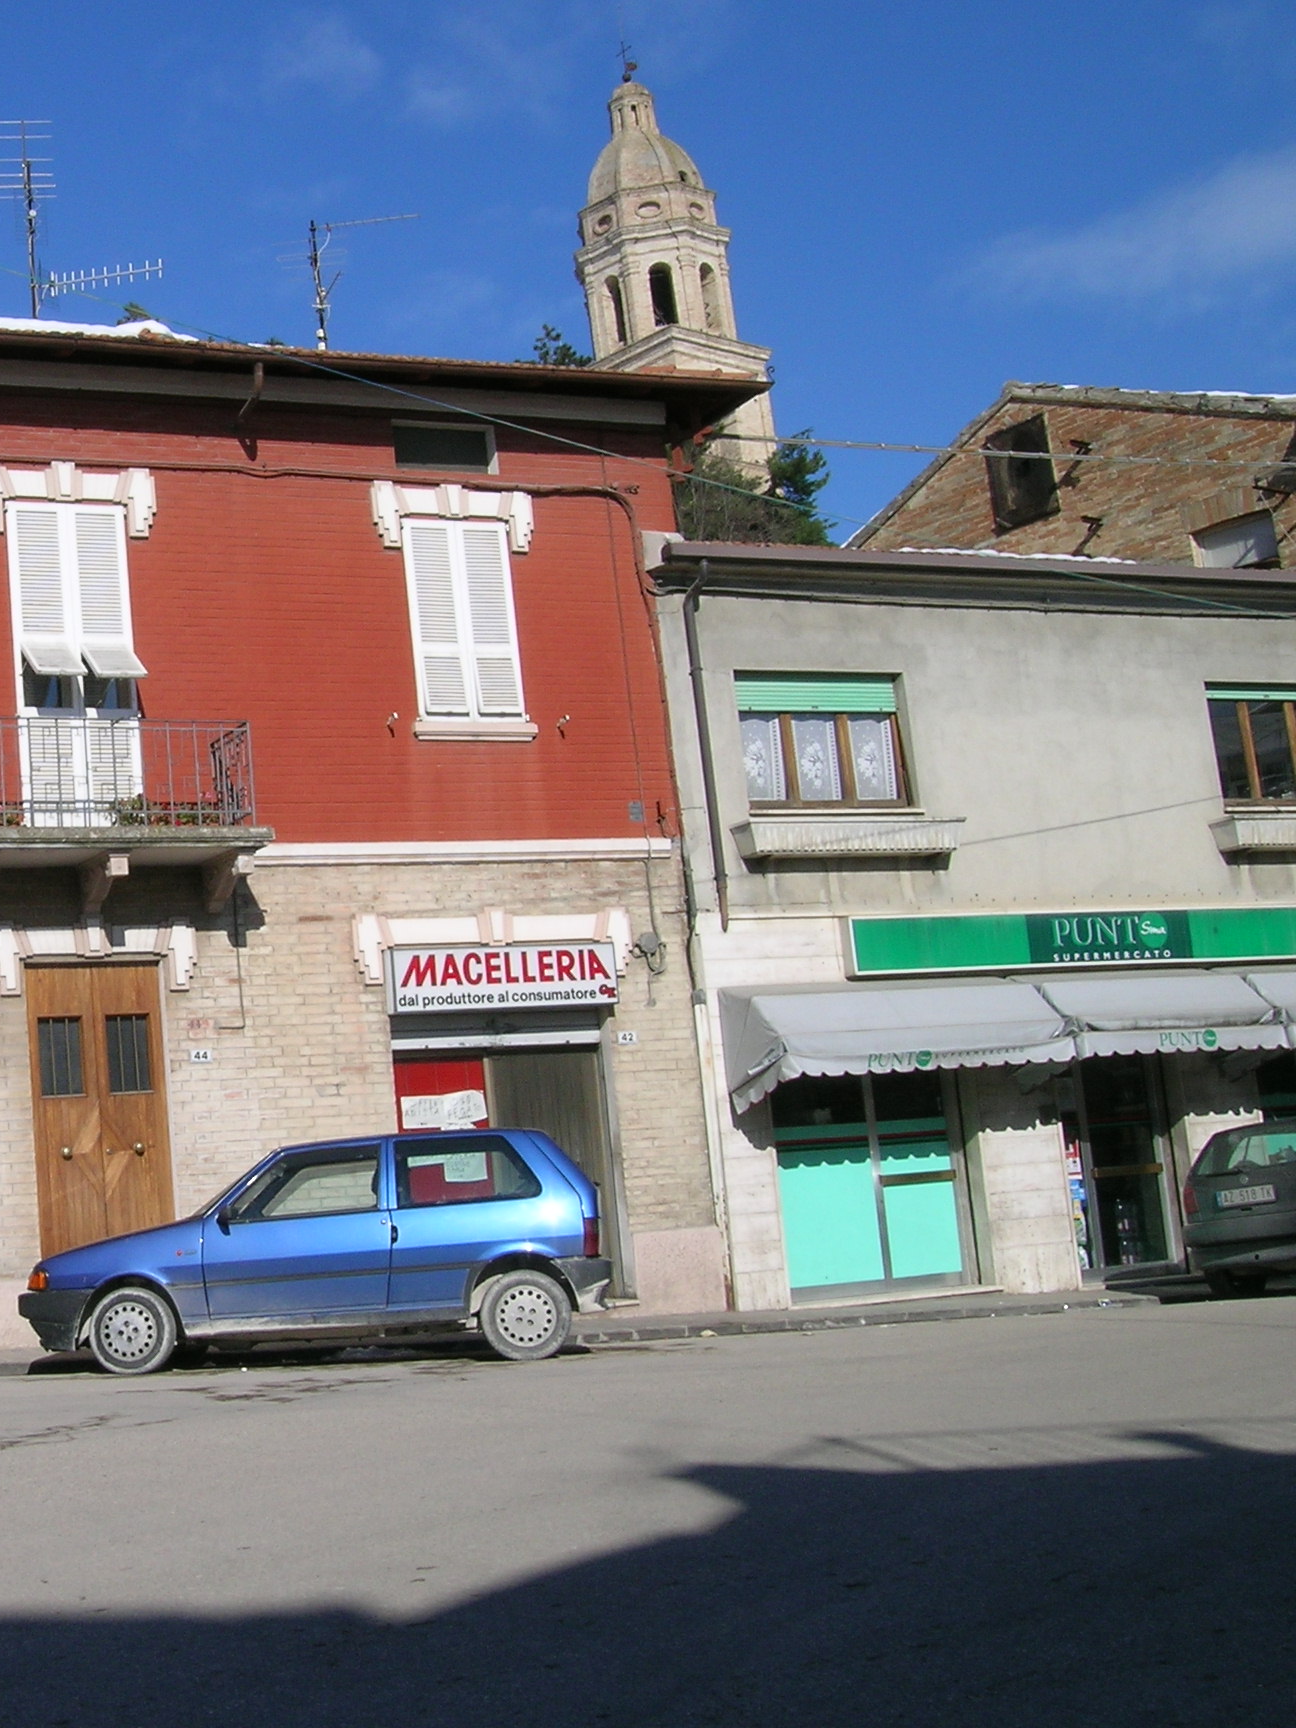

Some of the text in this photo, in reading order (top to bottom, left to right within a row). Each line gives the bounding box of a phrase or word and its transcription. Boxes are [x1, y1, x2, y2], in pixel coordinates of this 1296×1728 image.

[1052, 948, 1172, 962] SUPERMERCATO
[400, 949, 612, 988] MACELLERIA
[398, 988, 597, 1009] dal produttore al consumatore
[621, 1032, 634, 1042] 42
[194, 1051, 208, 1060] 44
